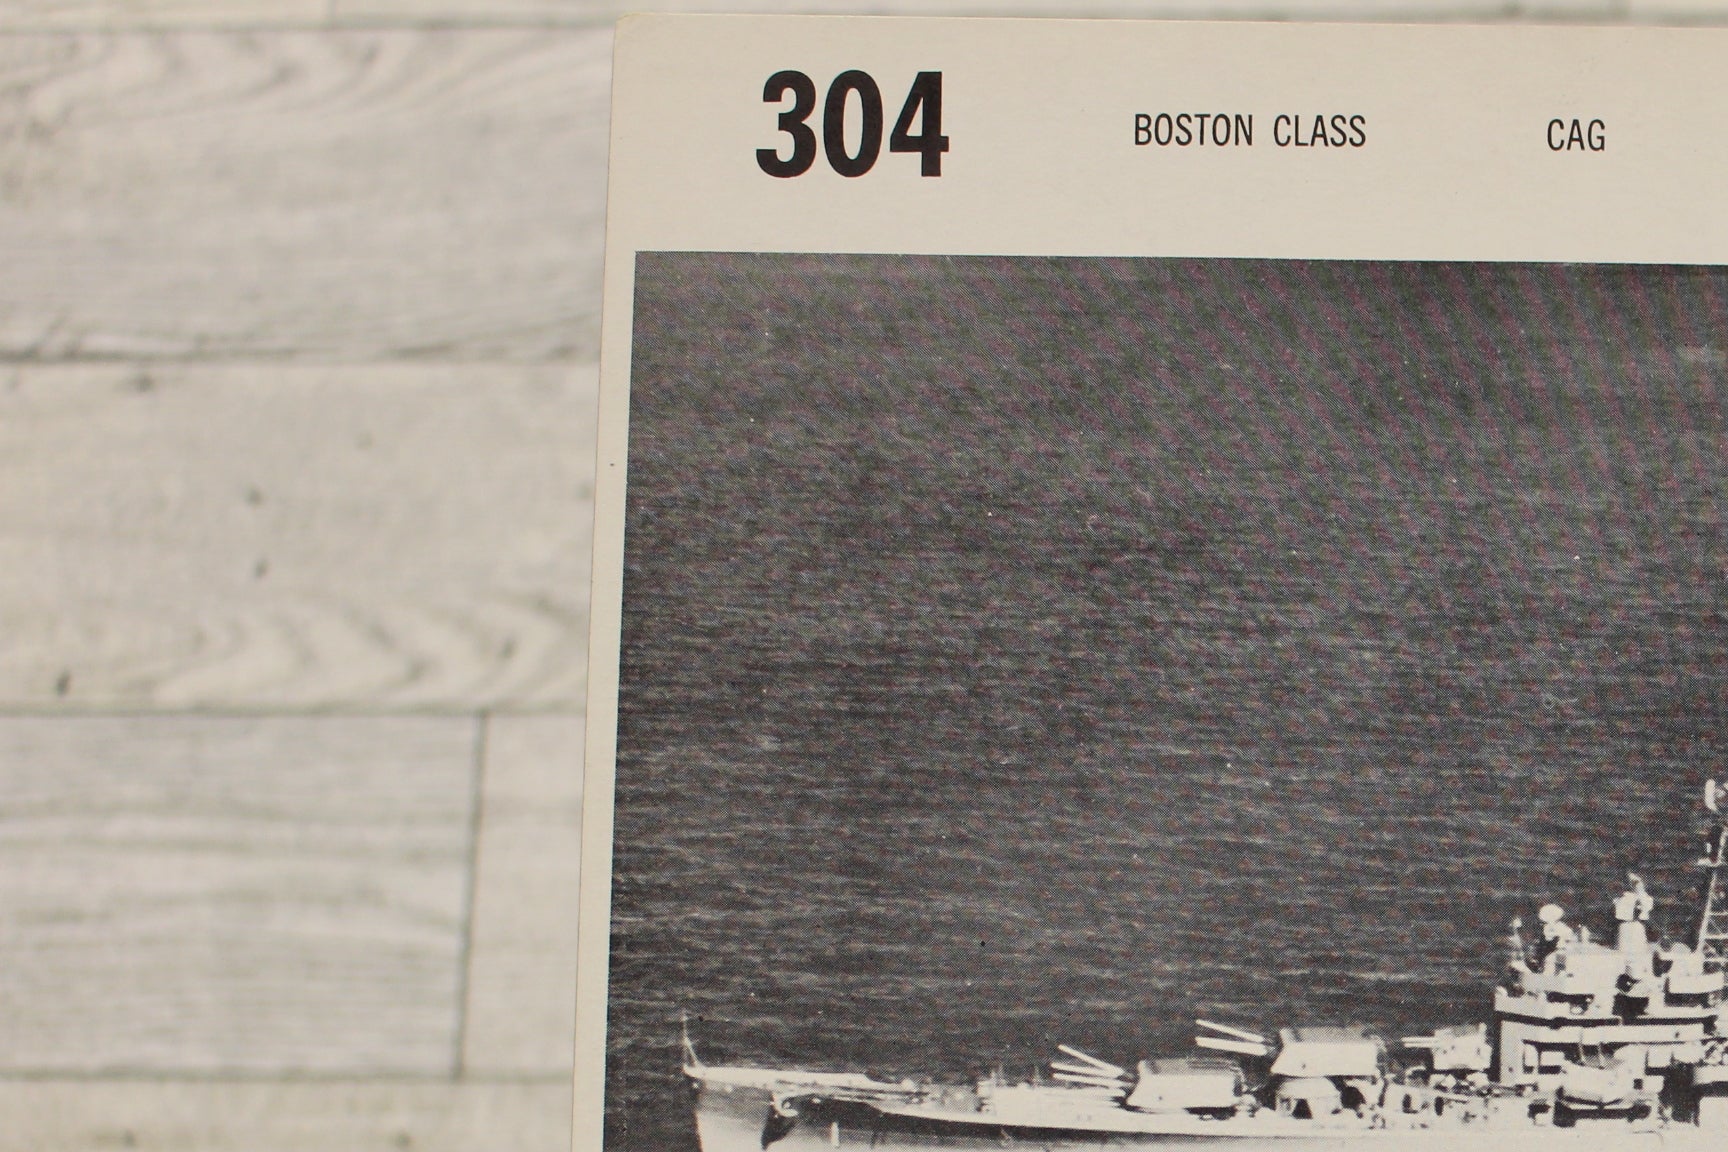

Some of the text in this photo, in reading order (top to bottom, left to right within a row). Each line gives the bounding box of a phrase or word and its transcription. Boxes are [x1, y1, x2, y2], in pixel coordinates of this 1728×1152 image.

[756, 70, 949, 178] 304
[1134, 112, 1366, 148] BOSTON CLASS
[1547, 118, 1606, 152] CAG
